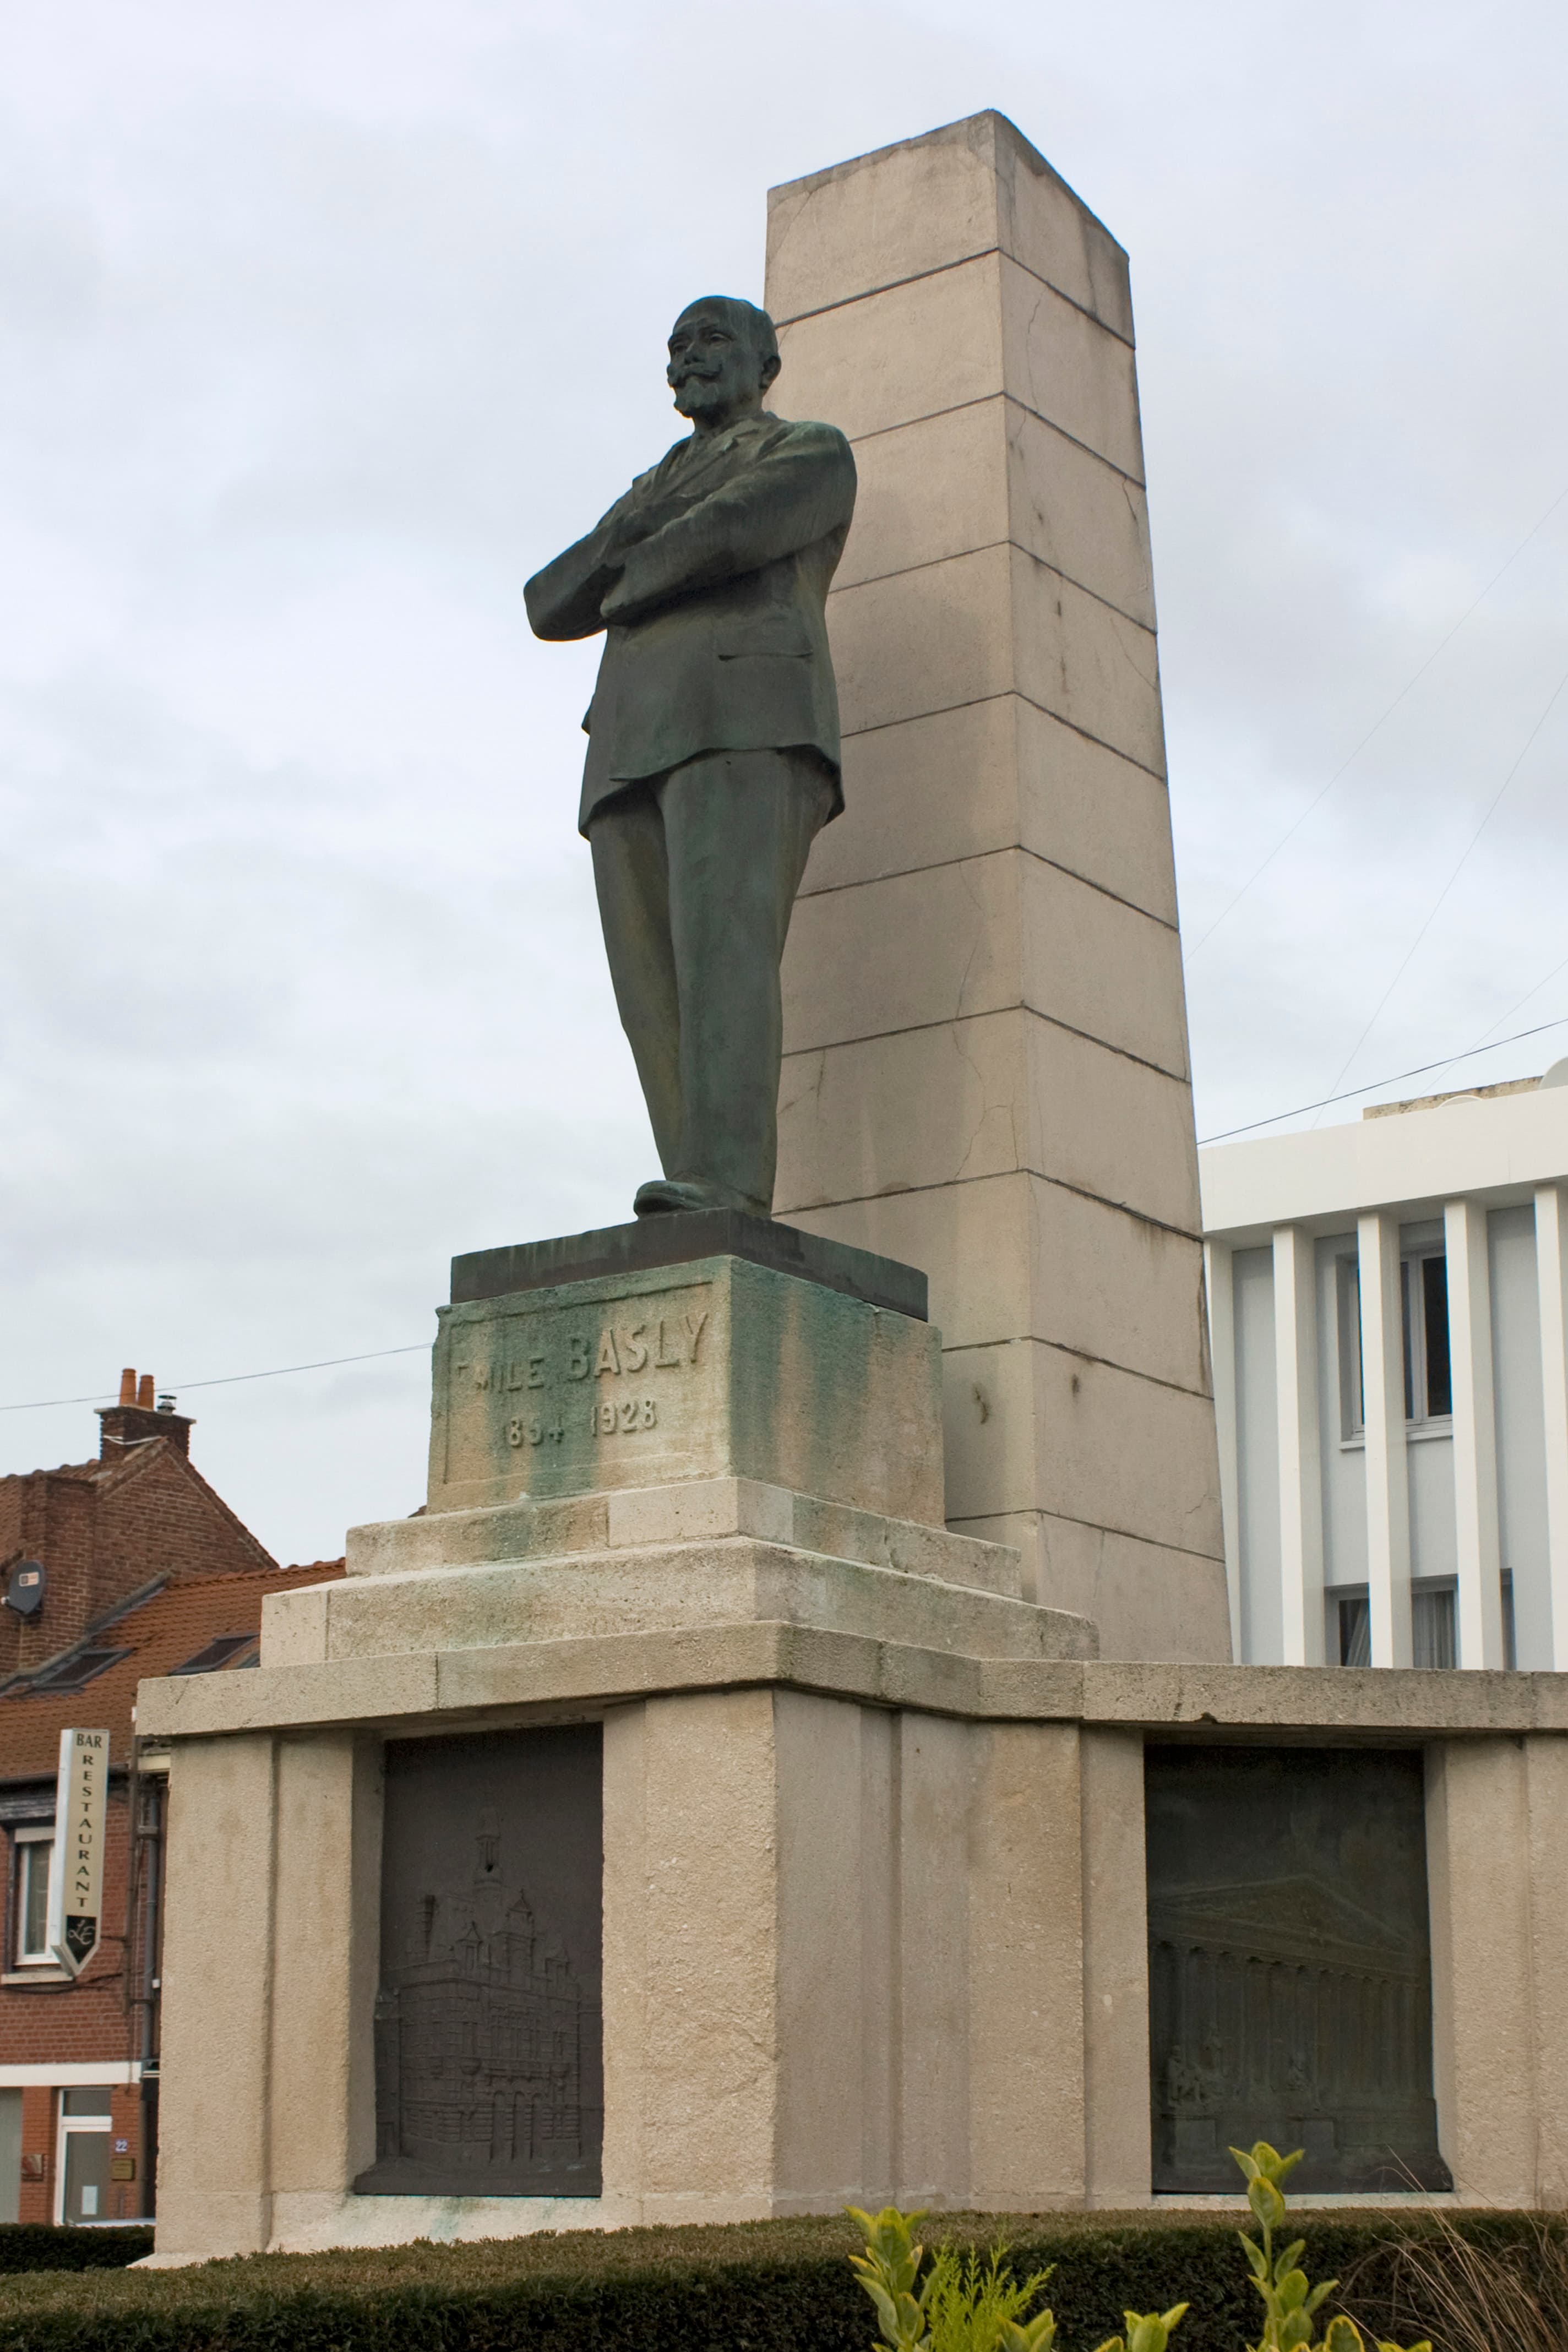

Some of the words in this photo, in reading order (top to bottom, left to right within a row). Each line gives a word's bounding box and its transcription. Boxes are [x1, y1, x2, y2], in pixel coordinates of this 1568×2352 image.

[567, 1313, 708, 1382] BASLY
[503, 1413, 564, 1447] 854
[591, 1400, 657, 1437] 1928
[76, 1733, 102, 1749] BAR
[75, 1755, 94, 1908] RESTAURANT
[115, 2140, 128, 2152] 22
